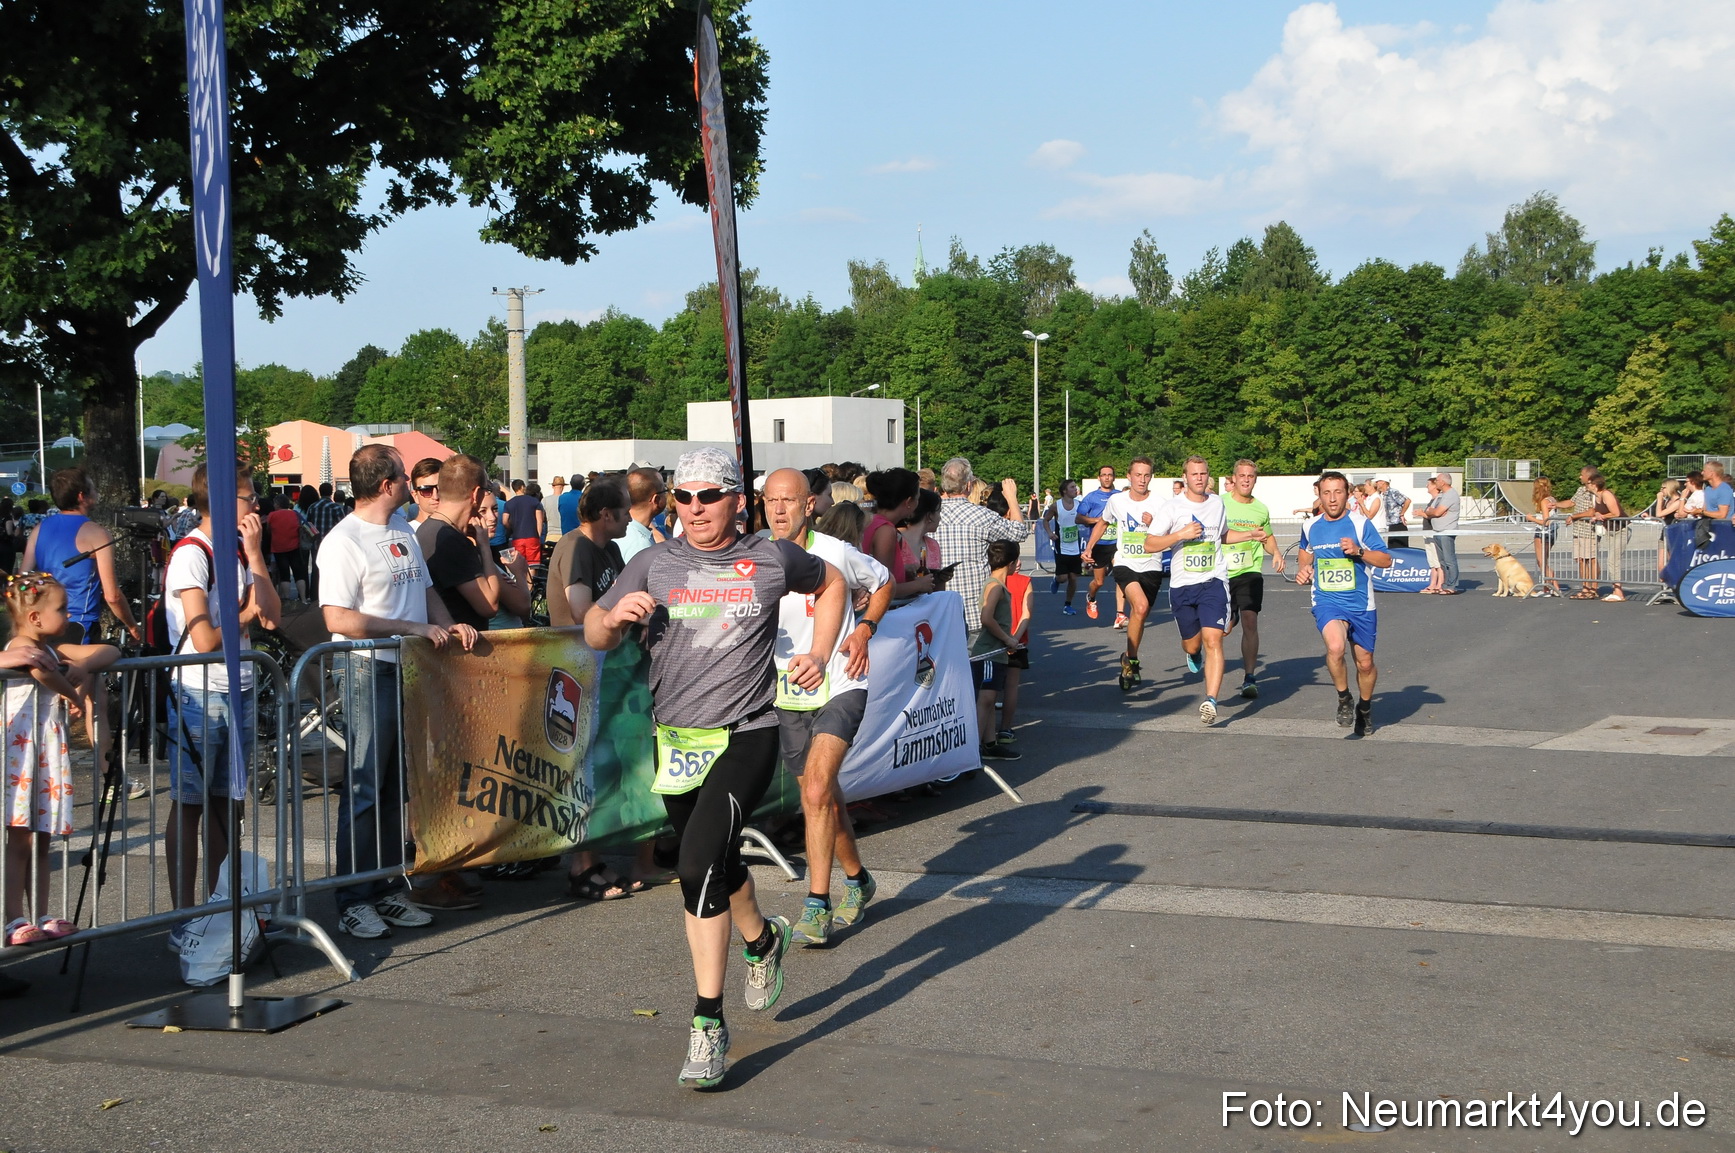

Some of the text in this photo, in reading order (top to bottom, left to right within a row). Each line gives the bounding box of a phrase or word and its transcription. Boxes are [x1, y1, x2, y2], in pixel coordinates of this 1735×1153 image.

[1123, 544, 1146, 554] 508
[1185, 555, 1213, 567] 5081
[1232, 552, 1246, 564] 37
[1319, 569, 1353, 583] 1258
[667, 588, 753, 604] FINISHER
[669, 603, 762, 618] RELAY 2013
[903, 696, 955, 731] Neumarkter
[892, 718, 967, 769] Lammsbräu
[668, 748, 716, 777] 568
